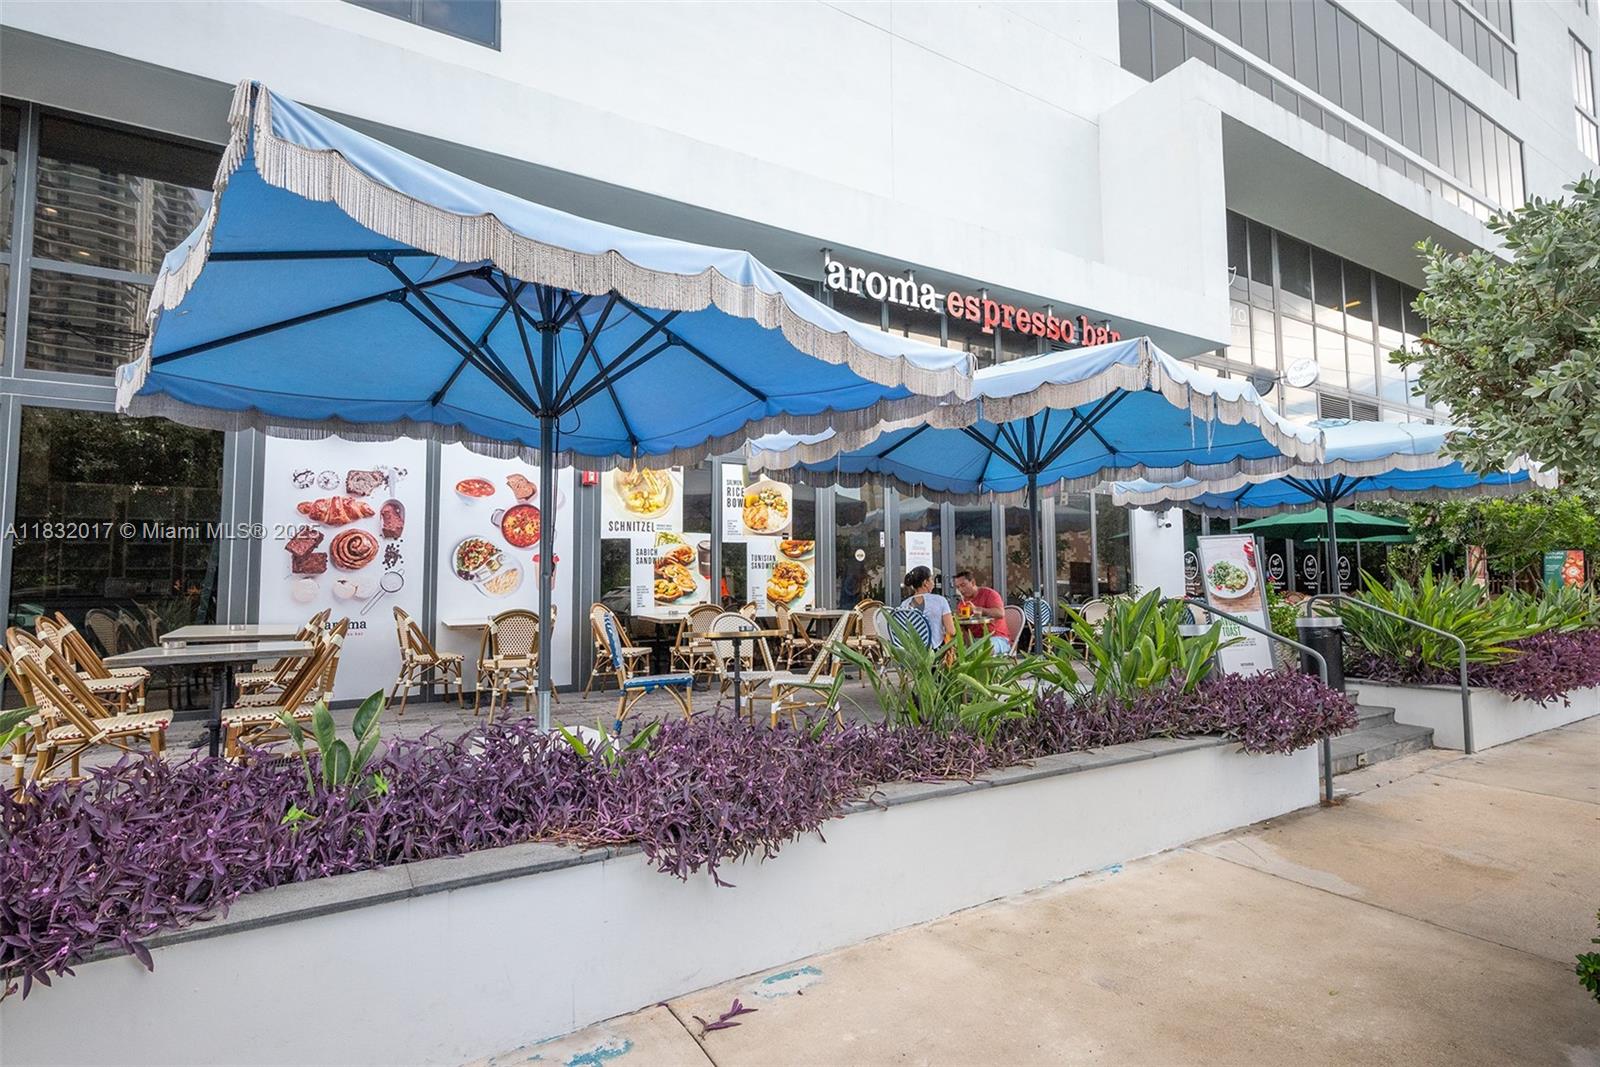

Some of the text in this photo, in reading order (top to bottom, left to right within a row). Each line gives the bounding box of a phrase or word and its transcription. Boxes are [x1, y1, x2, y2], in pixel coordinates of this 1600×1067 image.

[825, 259, 939, 313] aroma
[947, 291, 1075, 345] espresso
[726, 486, 745, 497] RICE
[726, 497, 748, 509] BOWL
[608, 520, 656, 532] SCHNITZEL
[635, 547, 658, 556] SABICH
[635, 556, 667, 565] SANDWIC
[751, 553, 776, 562] TUNISIAN
[324, 620, 367, 630] arma
[1222, 626, 1241, 637] TOAST
